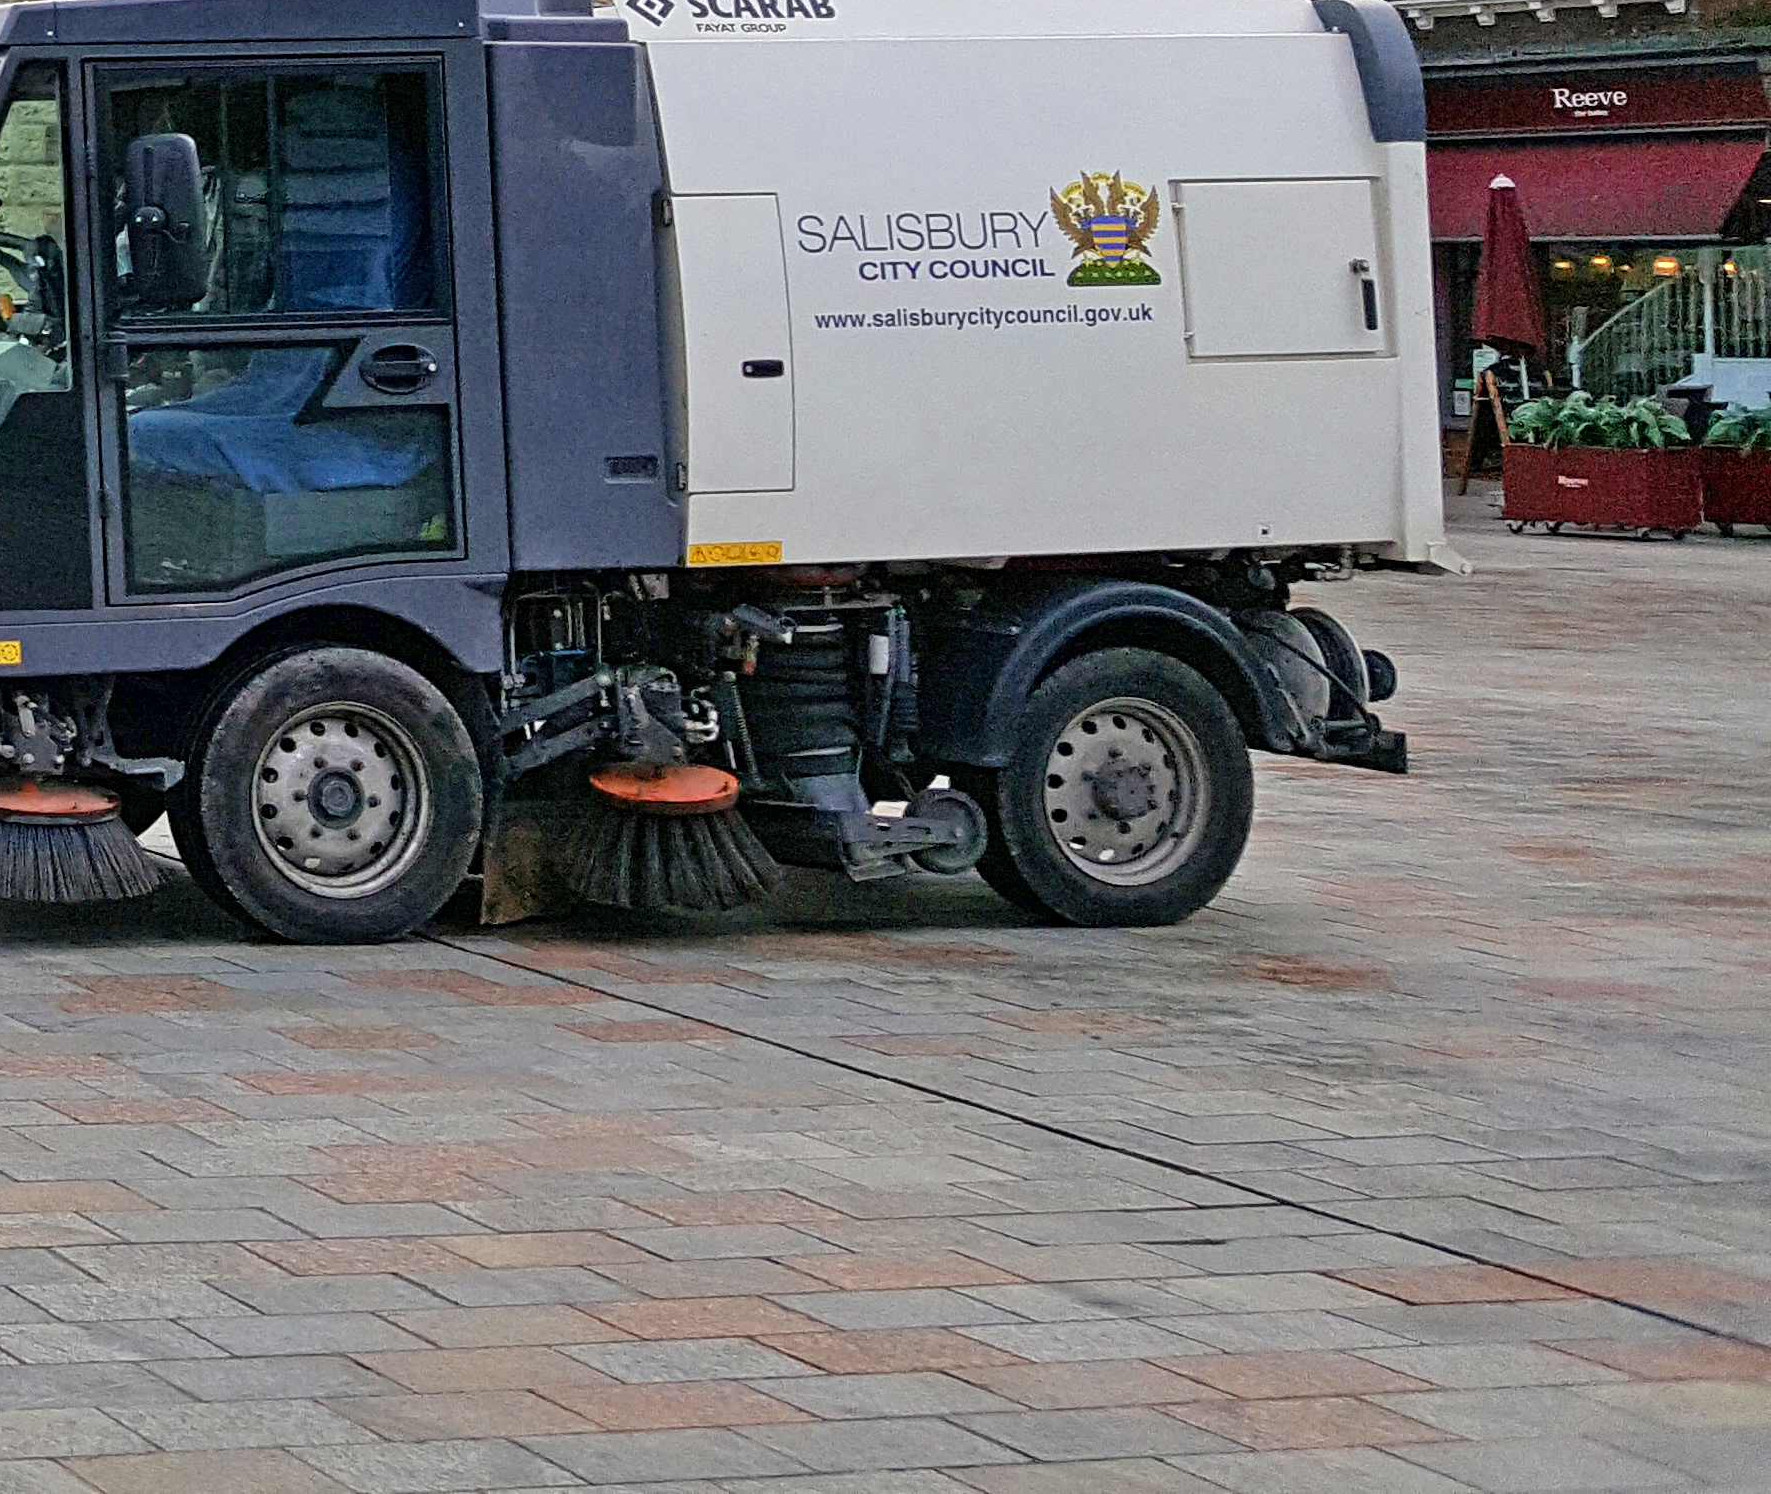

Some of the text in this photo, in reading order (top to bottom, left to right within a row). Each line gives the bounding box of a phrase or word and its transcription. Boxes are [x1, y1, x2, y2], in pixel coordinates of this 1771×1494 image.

[696, 23, 787, 33] FAYAT GROUP
[1552, 88, 1628, 108] Reeve
[797, 211, 1049, 253] SALISBURY
[859, 259, 1056, 280] CITY COUNCIL
[815, 305, 1153, 330] www.salisburycitycouncil.gov.uk
